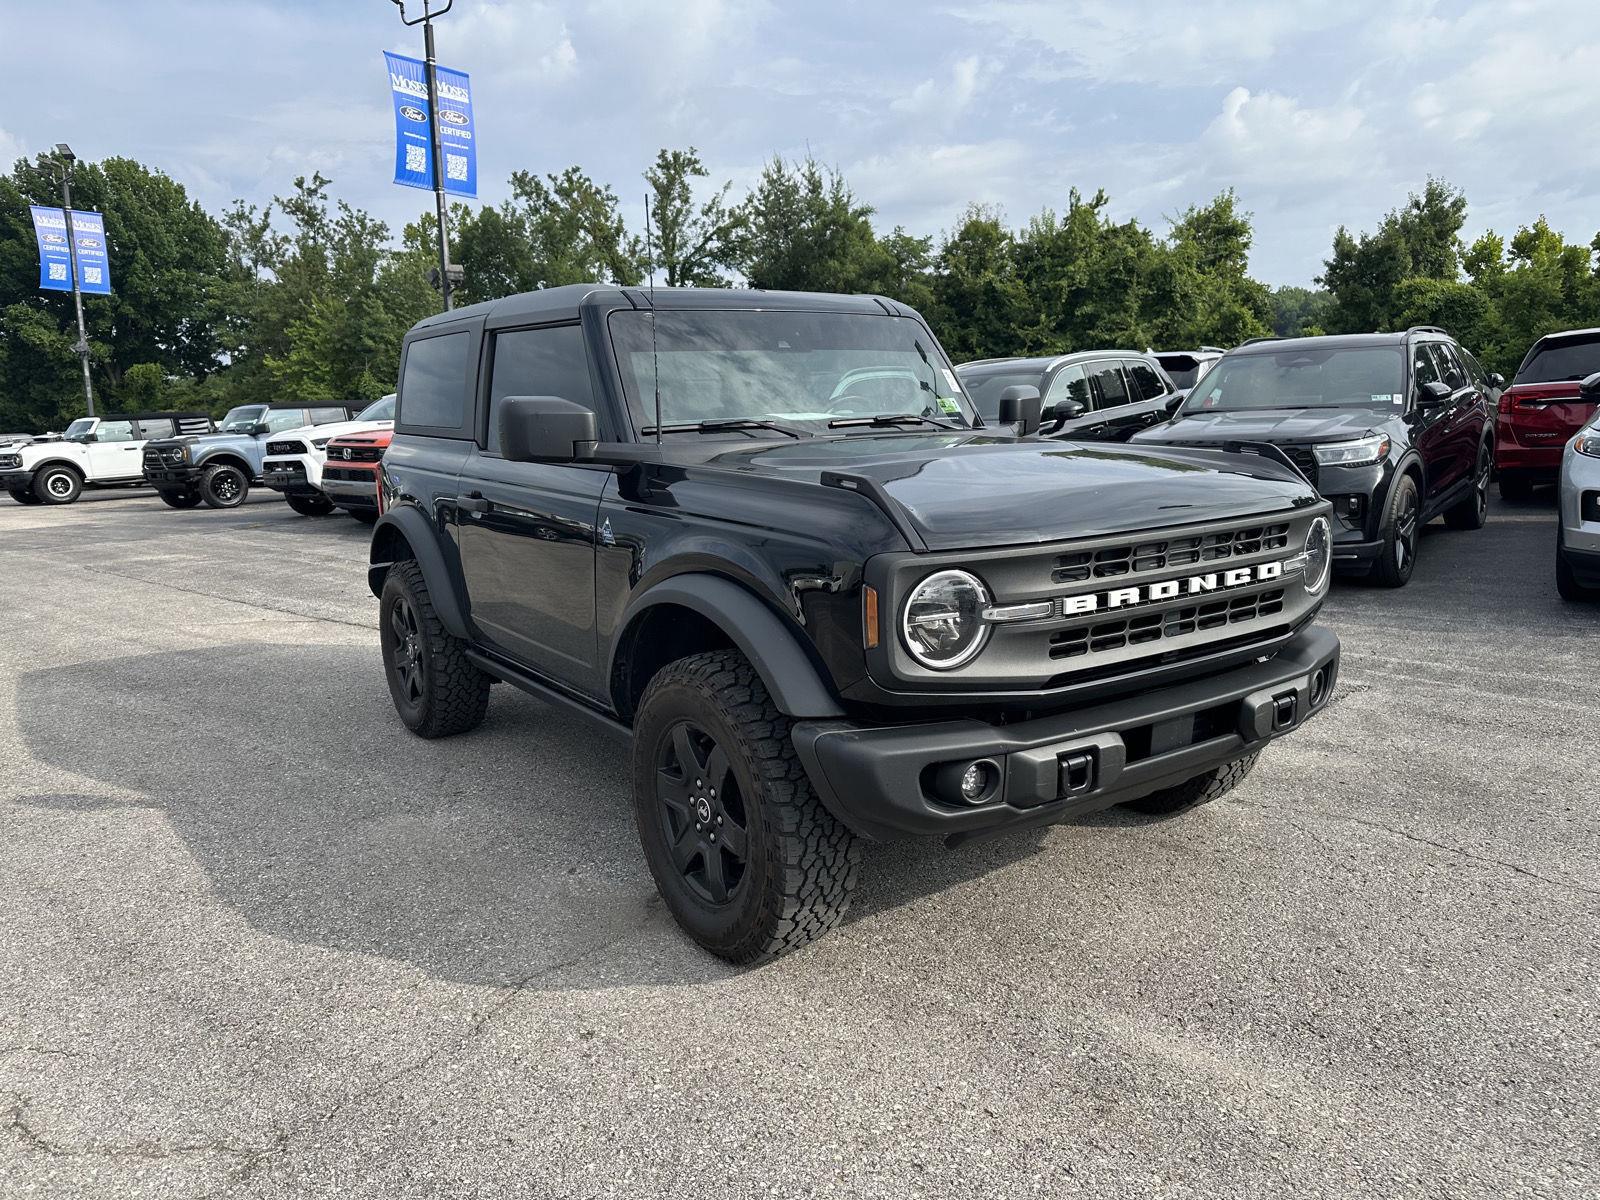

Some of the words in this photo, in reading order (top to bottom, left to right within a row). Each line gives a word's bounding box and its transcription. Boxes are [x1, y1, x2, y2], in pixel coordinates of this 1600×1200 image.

[391, 73, 428, 95] MOSES
[436, 80, 469, 98] MOSES
[440, 126, 472, 140] CERTIFIED
[1063, 561, 1282, 616] BRONCO
